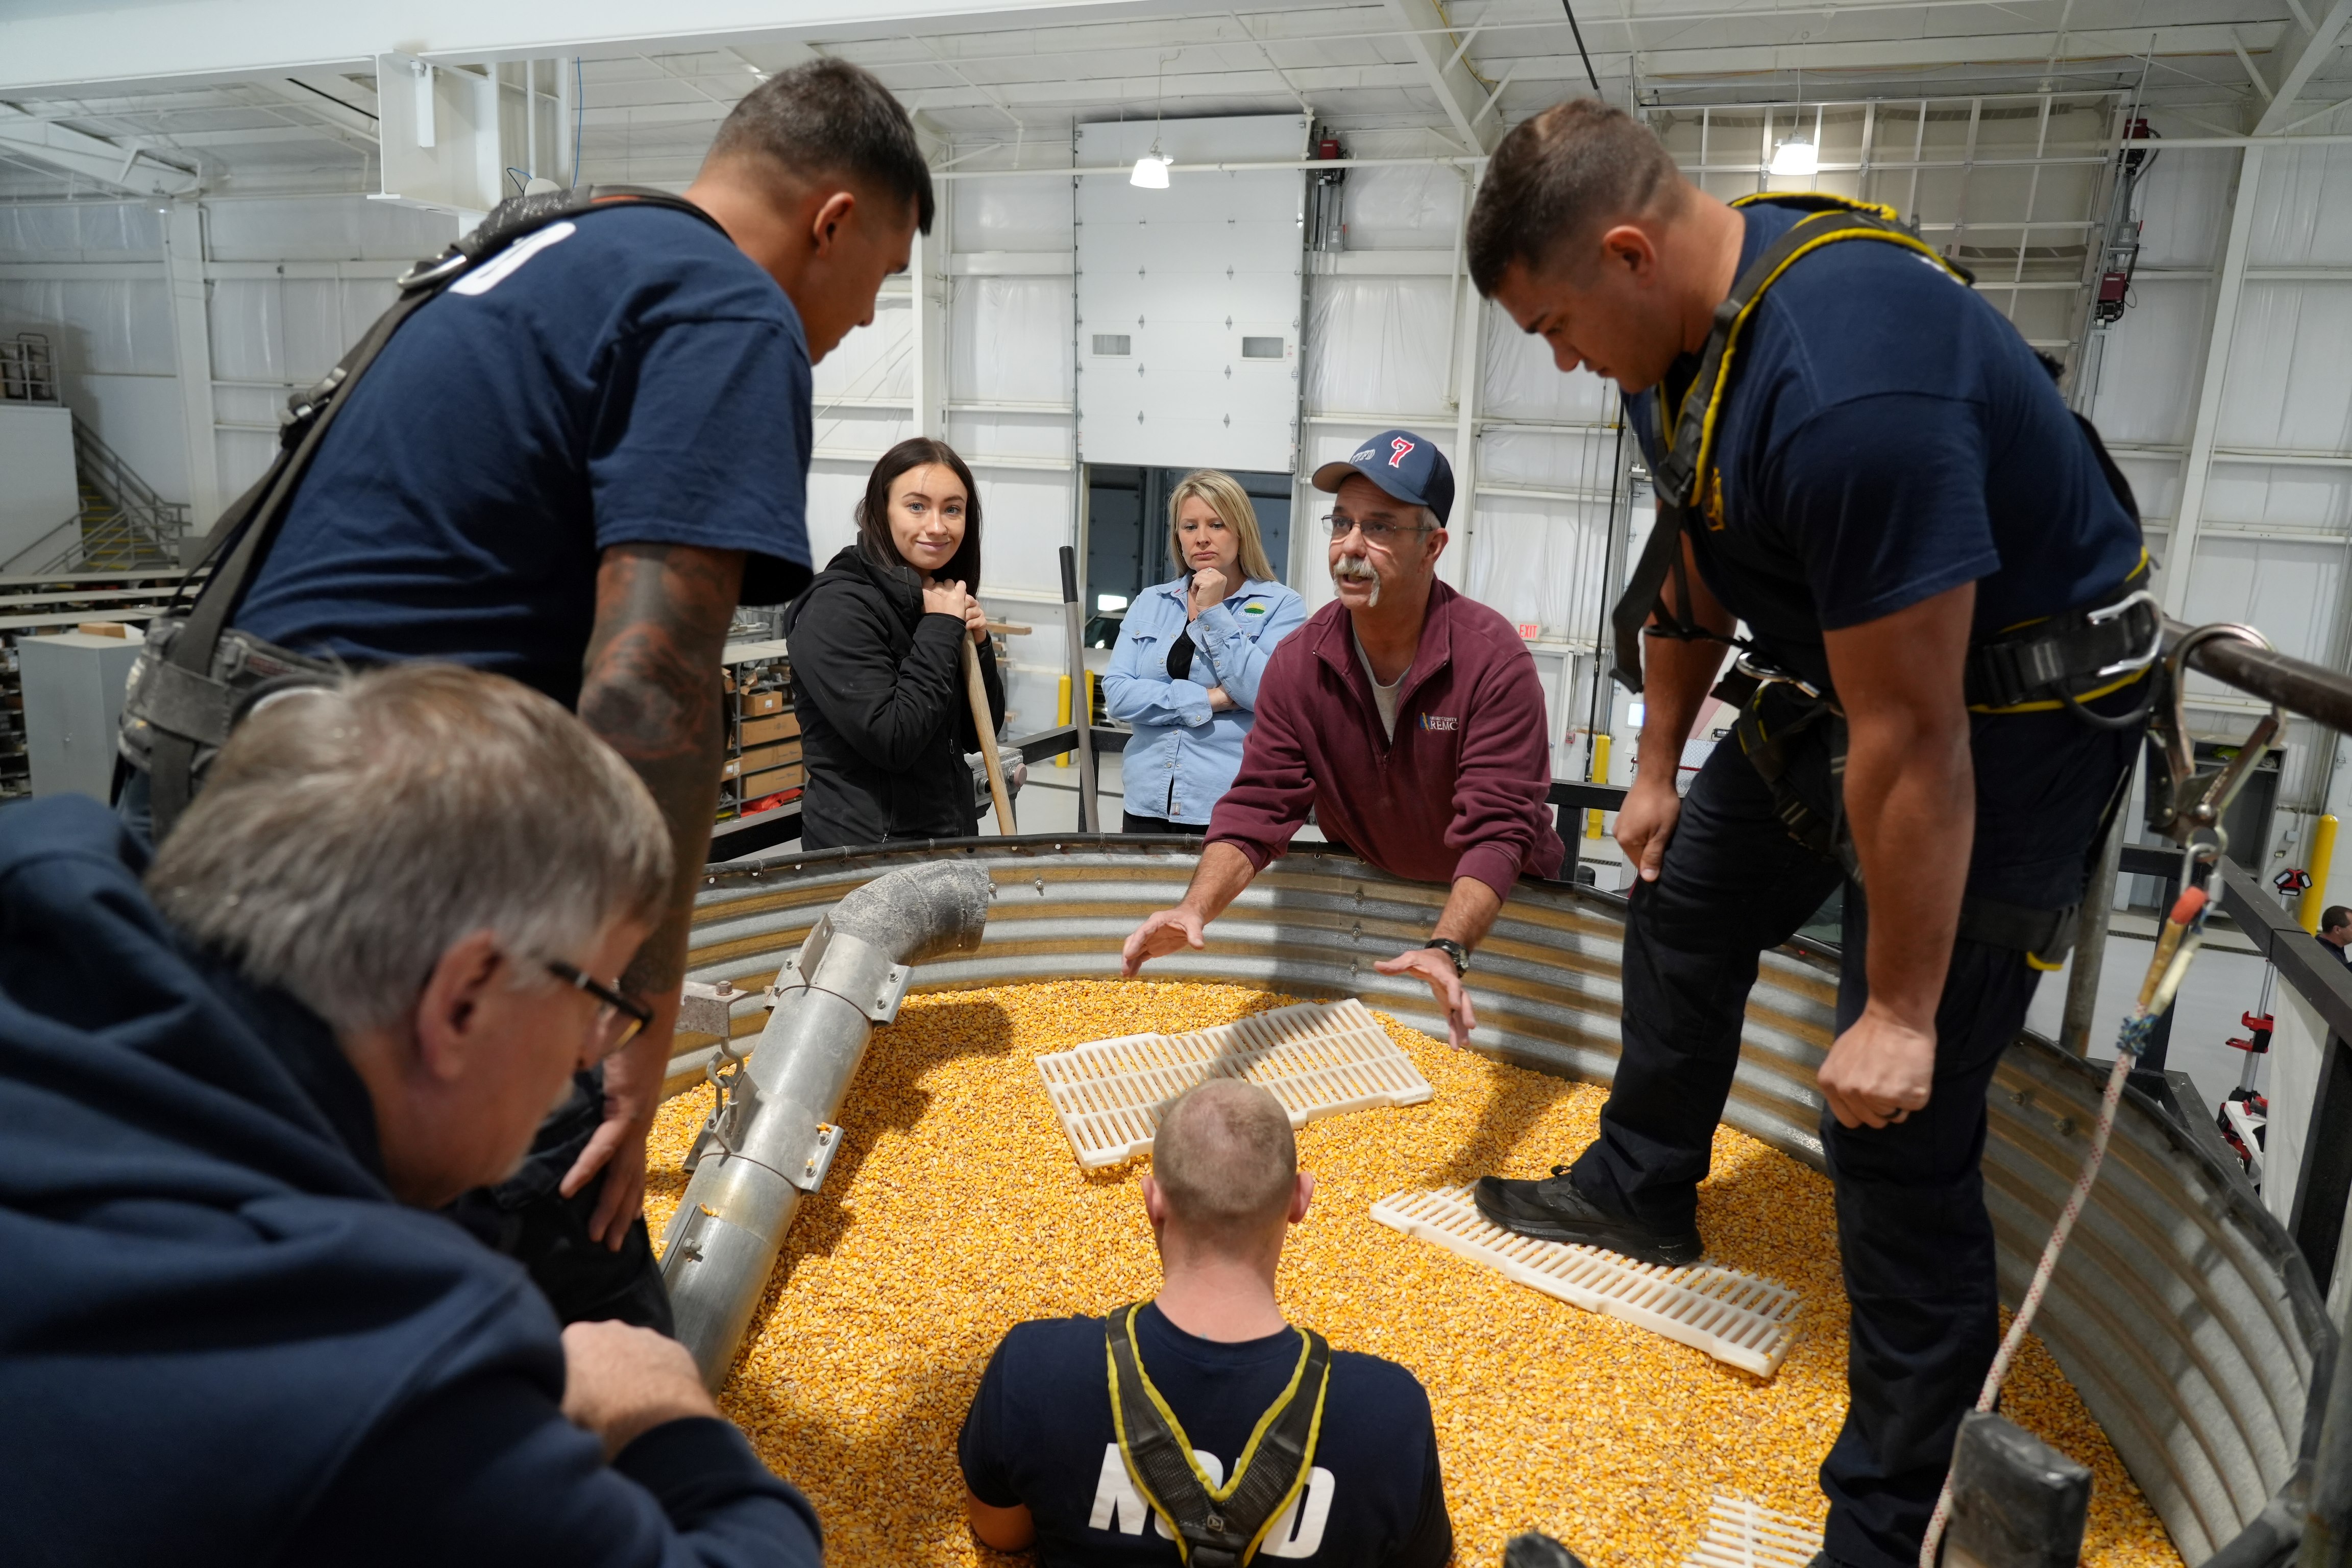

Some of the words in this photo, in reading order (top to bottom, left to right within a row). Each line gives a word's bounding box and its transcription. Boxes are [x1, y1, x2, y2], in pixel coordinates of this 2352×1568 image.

[1388, 436, 1415, 469] 7
[1520, 624, 1537, 638] EXIT
[1430, 720, 1459, 731] REMC
[1088, 1442, 1335, 1558] ND
